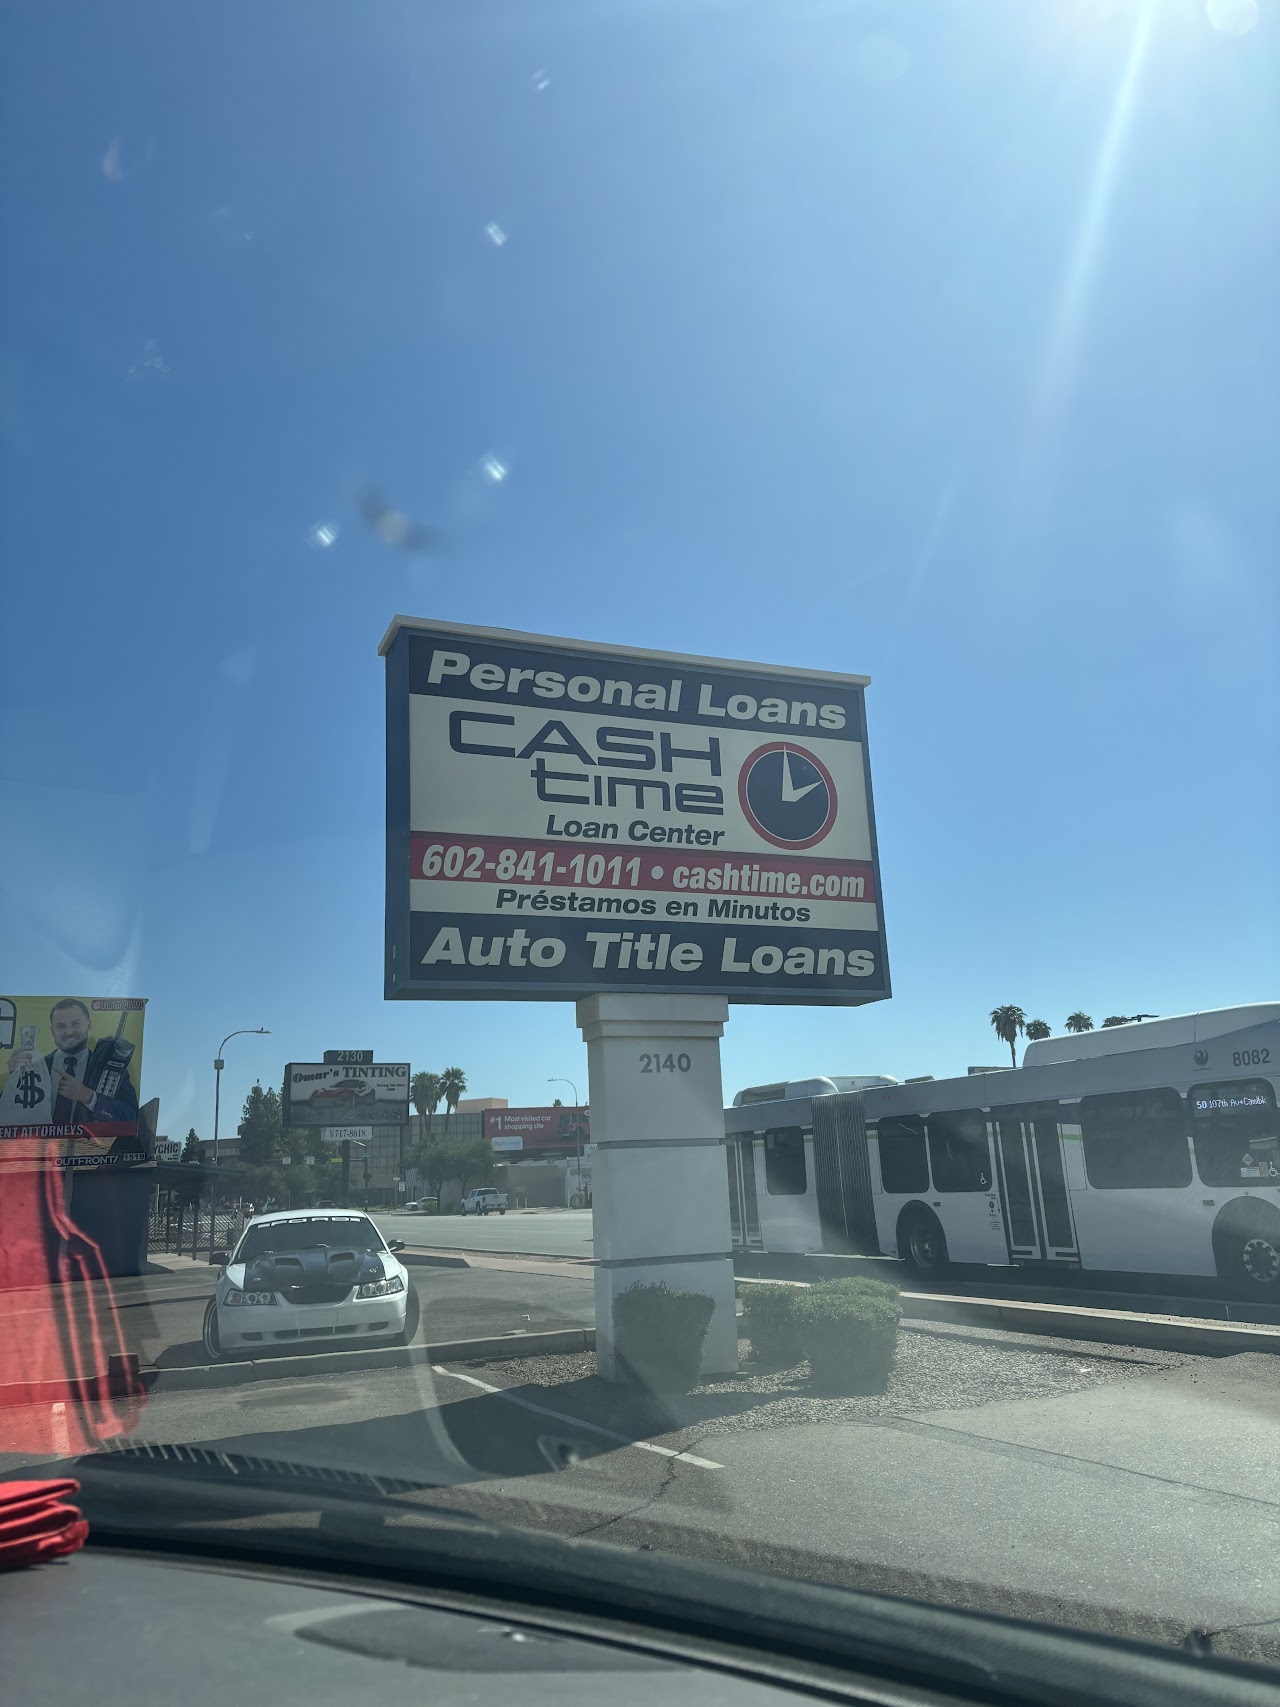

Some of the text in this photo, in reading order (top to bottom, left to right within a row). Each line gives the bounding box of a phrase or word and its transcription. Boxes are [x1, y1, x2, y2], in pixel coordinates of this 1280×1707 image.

[427, 650, 847, 730] Personal Loans
[449, 710, 722, 776] CASH
[530, 758, 724, 815] time
[547, 814, 725, 846] Loan Center
[422, 844, 865, 898] 602-841-1011 cashtime.com
[496, 888, 811, 922] Préstamos en Minutos
[421, 926, 875, 977] Auto Title Loans
[337, 1050, 363, 1061] 2130
[639, 1053, 691, 1073] 2140
[1232, 1048, 1271, 1067] 8082
[342, 1066, 406, 1078] TINTING
[1196, 1100, 1208, 1109] 50
[20, 1124, 83, 1138] ATTORNEYS
